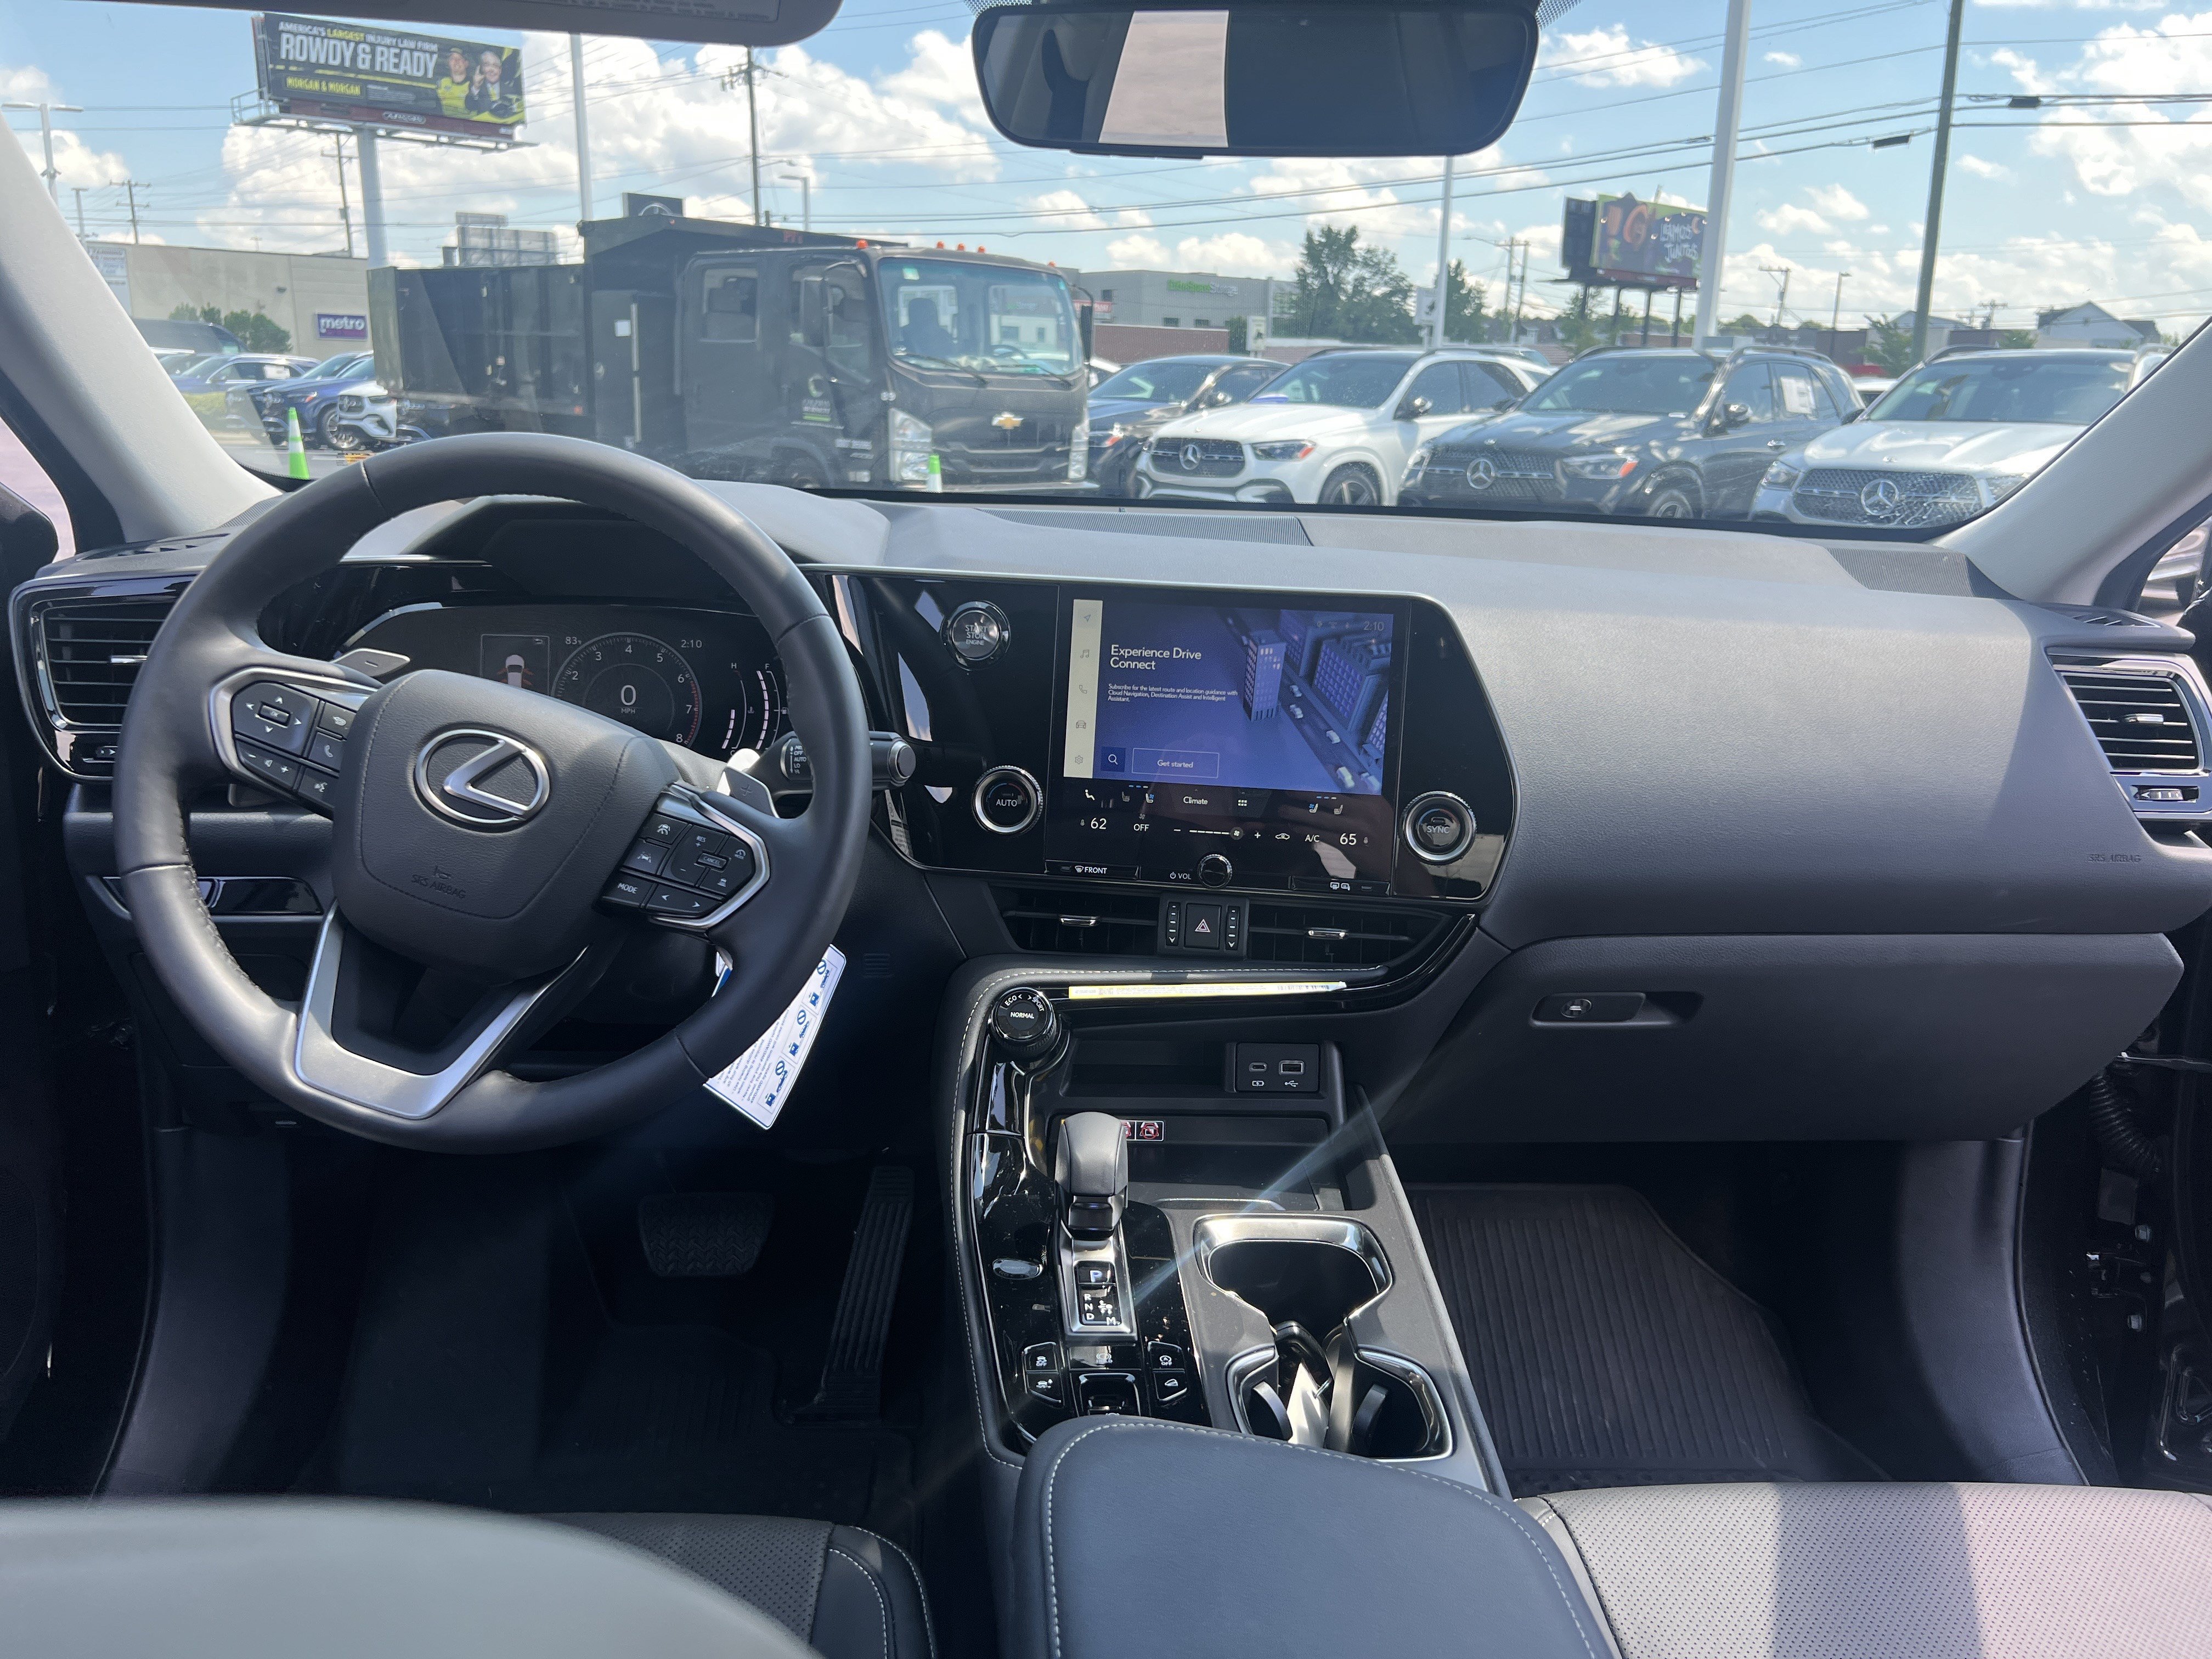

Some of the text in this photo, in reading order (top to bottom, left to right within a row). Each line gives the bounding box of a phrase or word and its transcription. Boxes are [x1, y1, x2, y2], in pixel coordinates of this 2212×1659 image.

[278, 21, 438, 52] AMERICA'S LARGEST INJURY LAW FIRM
[280, 32, 438, 78] ROWDY & READY
[286, 76, 320, 90] MORGAN
[321, 81, 328, 92] &
[328, 82, 361, 96] MORGAN
[320, 317, 365, 333] metro
[965, 625, 986, 633] START
[1363, 621, 1385, 631] 2:10
[681, 640, 702, 648] 2:10
[625, 645, 632, 654] 4
[1111, 644, 1201, 660] Experience Drive
[595, 652, 602, 661] 3
[657, 653, 663, 663] 5
[1110, 657, 1156, 670] Connect
[572, 671, 578, 680] 2
[678, 674, 685, 684] 6
[620, 685, 636, 706] 0
[686, 704, 692, 714] 7
[676, 733, 683, 743] 8
[1157, 759, 1193, 768] Get started
[996, 798, 1017, 807] AUTO
[1183, 796, 1208, 805] Climate
[1090, 818, 1107, 830] 62
[1133, 823, 1149, 832] OFF
[1427, 825, 1450, 833] SYNC
[1305, 834, 1320, 843] A/C
[1339, 833, 1357, 845] 65
[1084, 866, 1107, 874] FRONT
[430, 882, 466, 899] AIRBAG
[618, 882, 638, 895] MODE
[1005, 995, 1017, 1006] ECO
[1031, 996, 1044, 1012] SPORT
[1090, 1270, 1102, 1283] P
[1106, 1317, 1116, 1325] M
